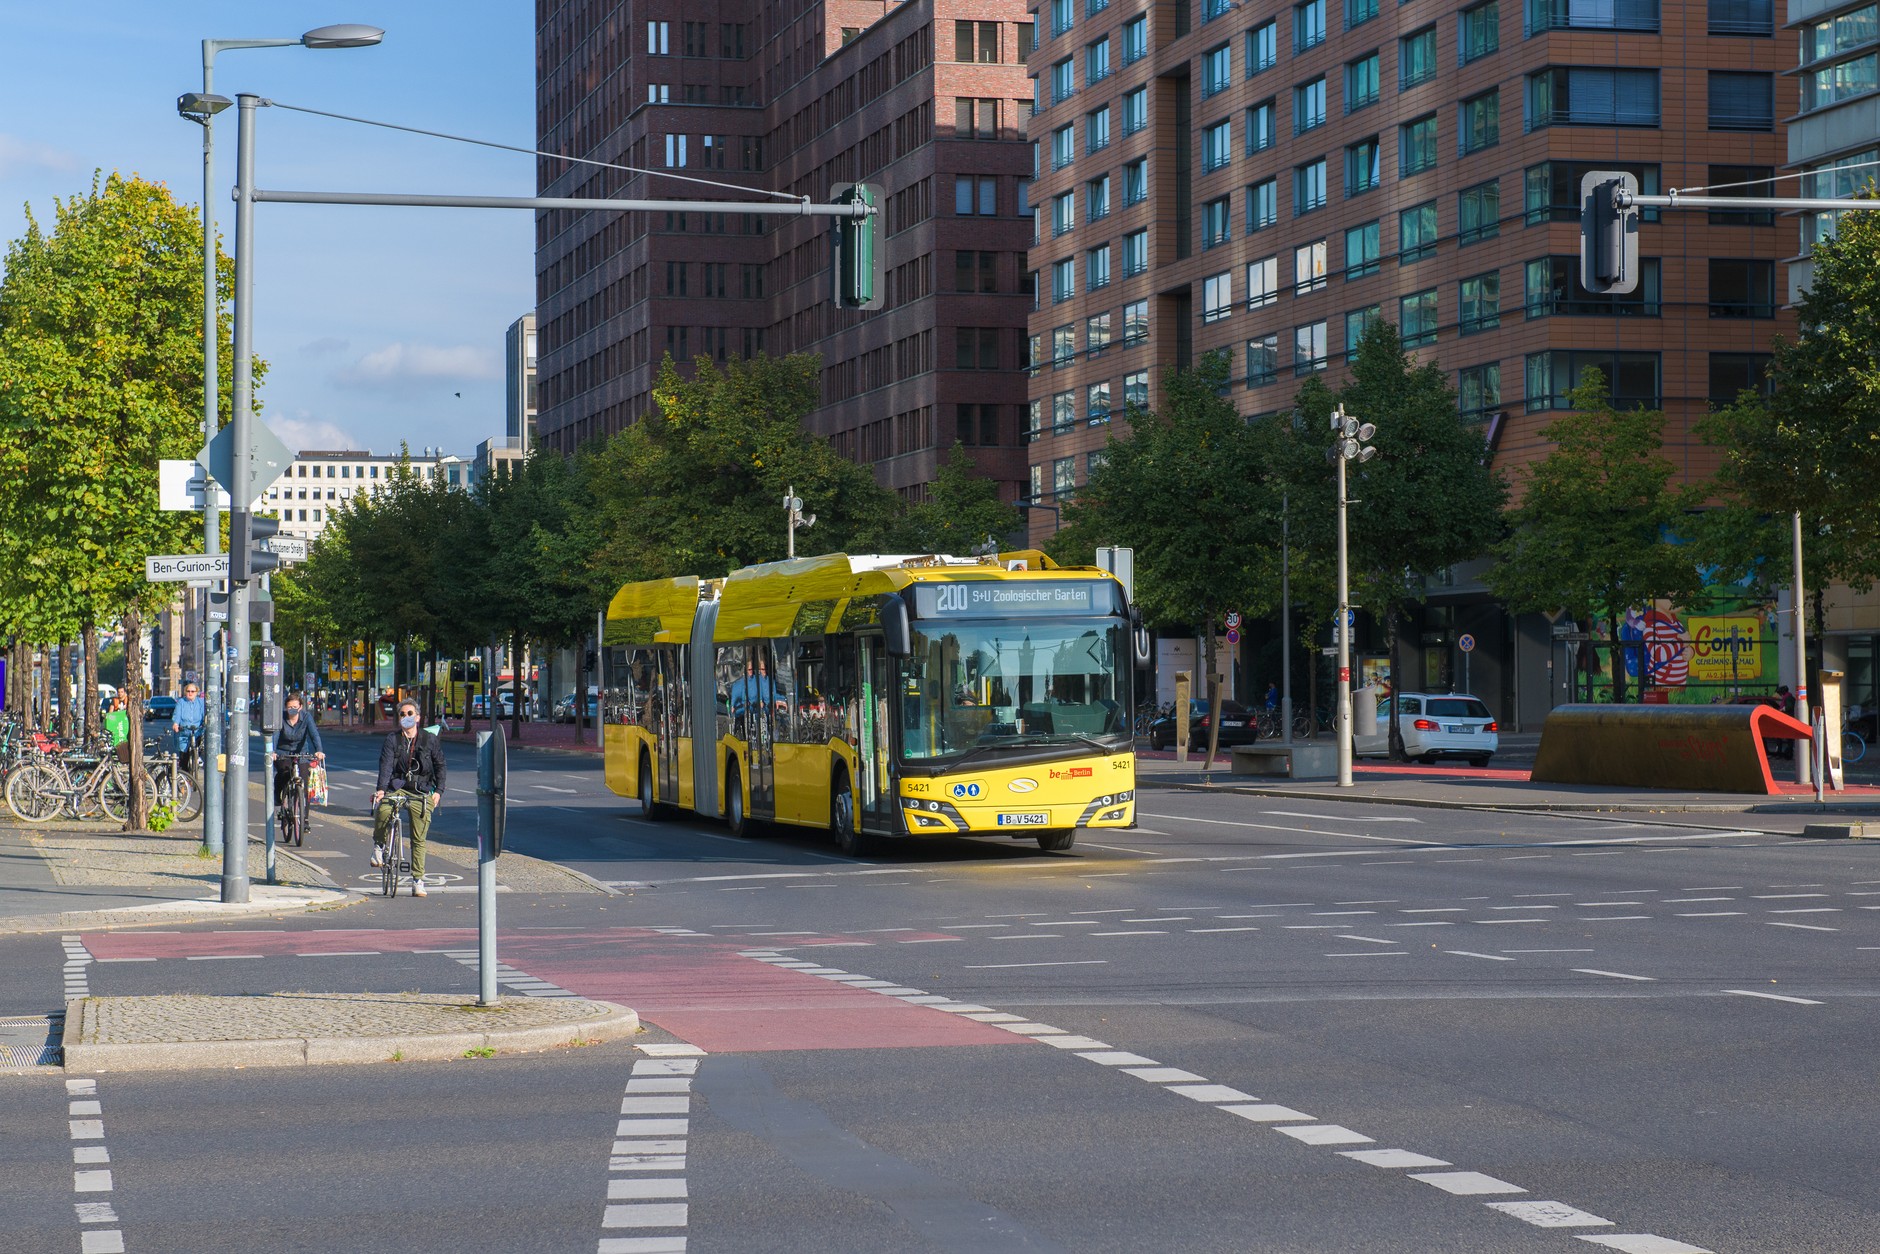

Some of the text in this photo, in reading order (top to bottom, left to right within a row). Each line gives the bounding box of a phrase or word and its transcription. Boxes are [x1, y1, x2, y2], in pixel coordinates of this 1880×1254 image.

[291, 543, 304, 556] Straße
[937, 585, 1087, 611] 200 S+U Zoologischer Garten
[1227, 614, 1238, 624] 30
[1695, 625, 1753, 657] Conni
[263, 648, 276, 658] R 4
[1112, 761, 1130, 770] 5421
[1049, 769, 1061, 779] be
[907, 784, 930, 792] 5421
[1005, 815, 1044, 824] B V 5421
